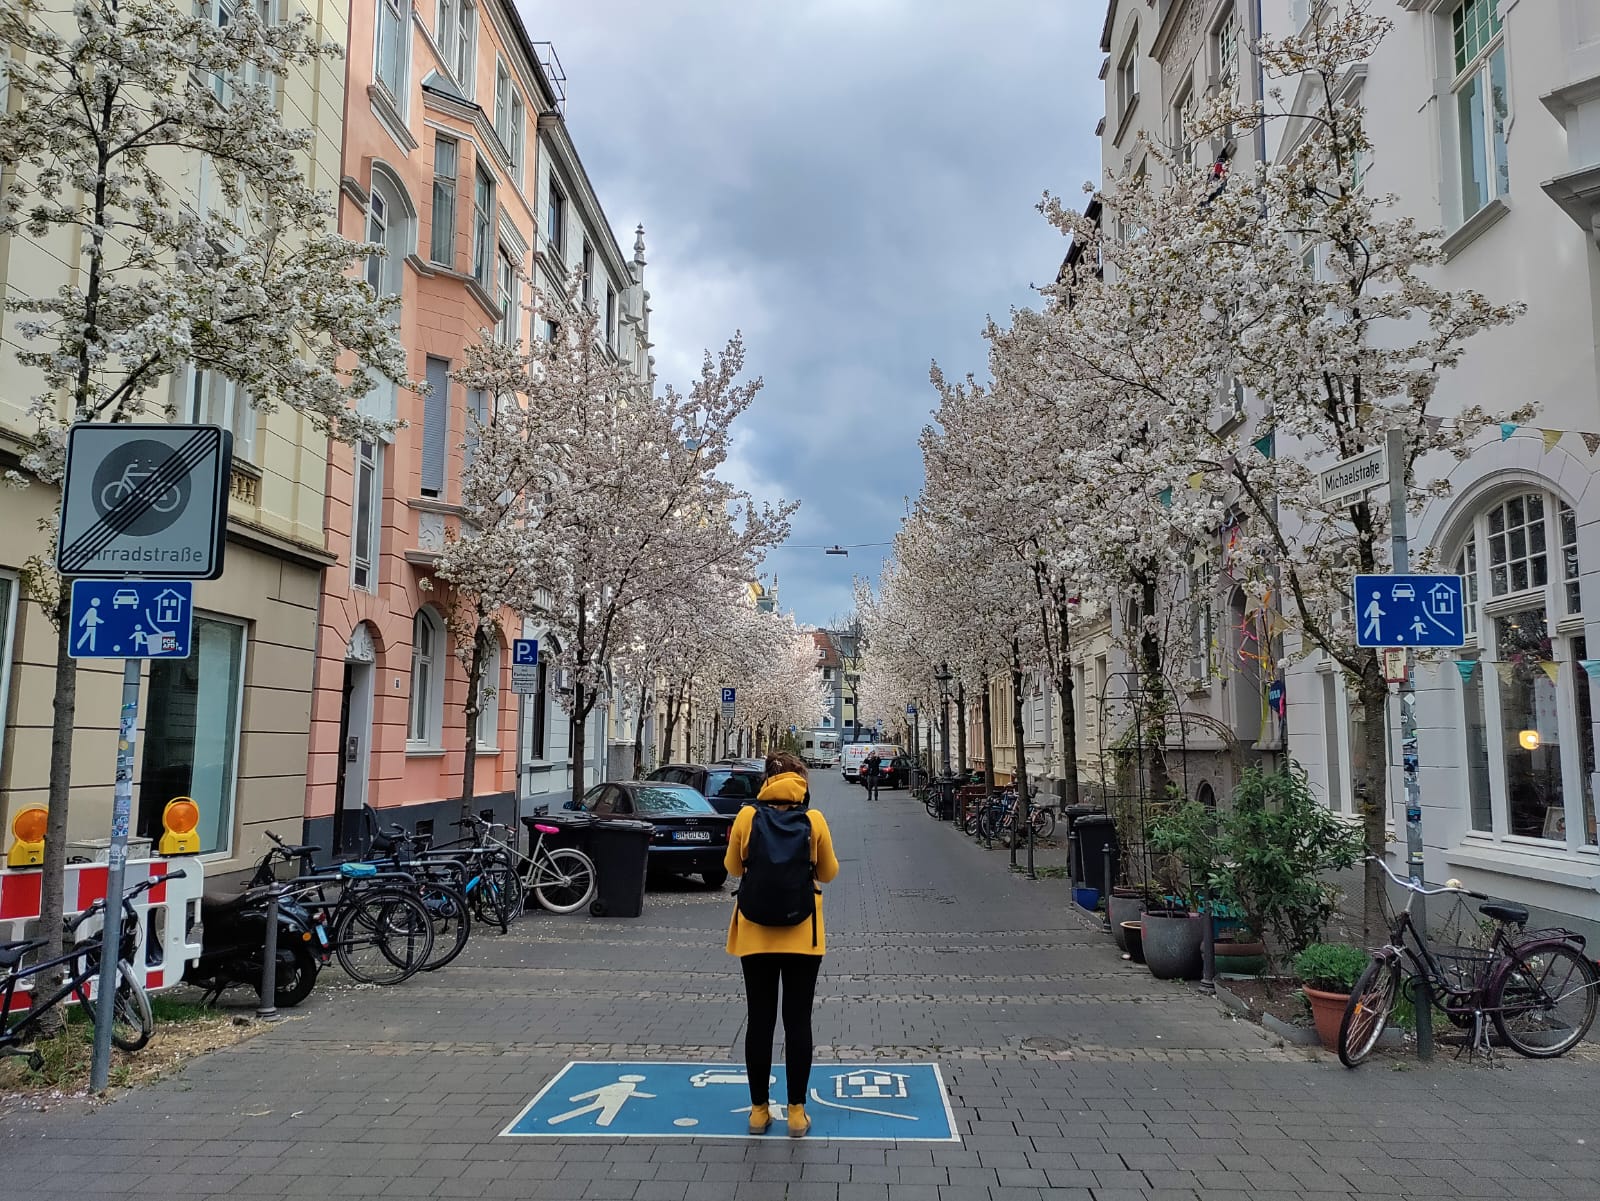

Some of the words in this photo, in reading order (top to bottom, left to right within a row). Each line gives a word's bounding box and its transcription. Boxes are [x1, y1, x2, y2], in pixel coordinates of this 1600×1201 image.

[1325, 459, 1380, 493] Michaelstraße
[516, 642, 530, 661] P
[724, 689, 732, 700] P
